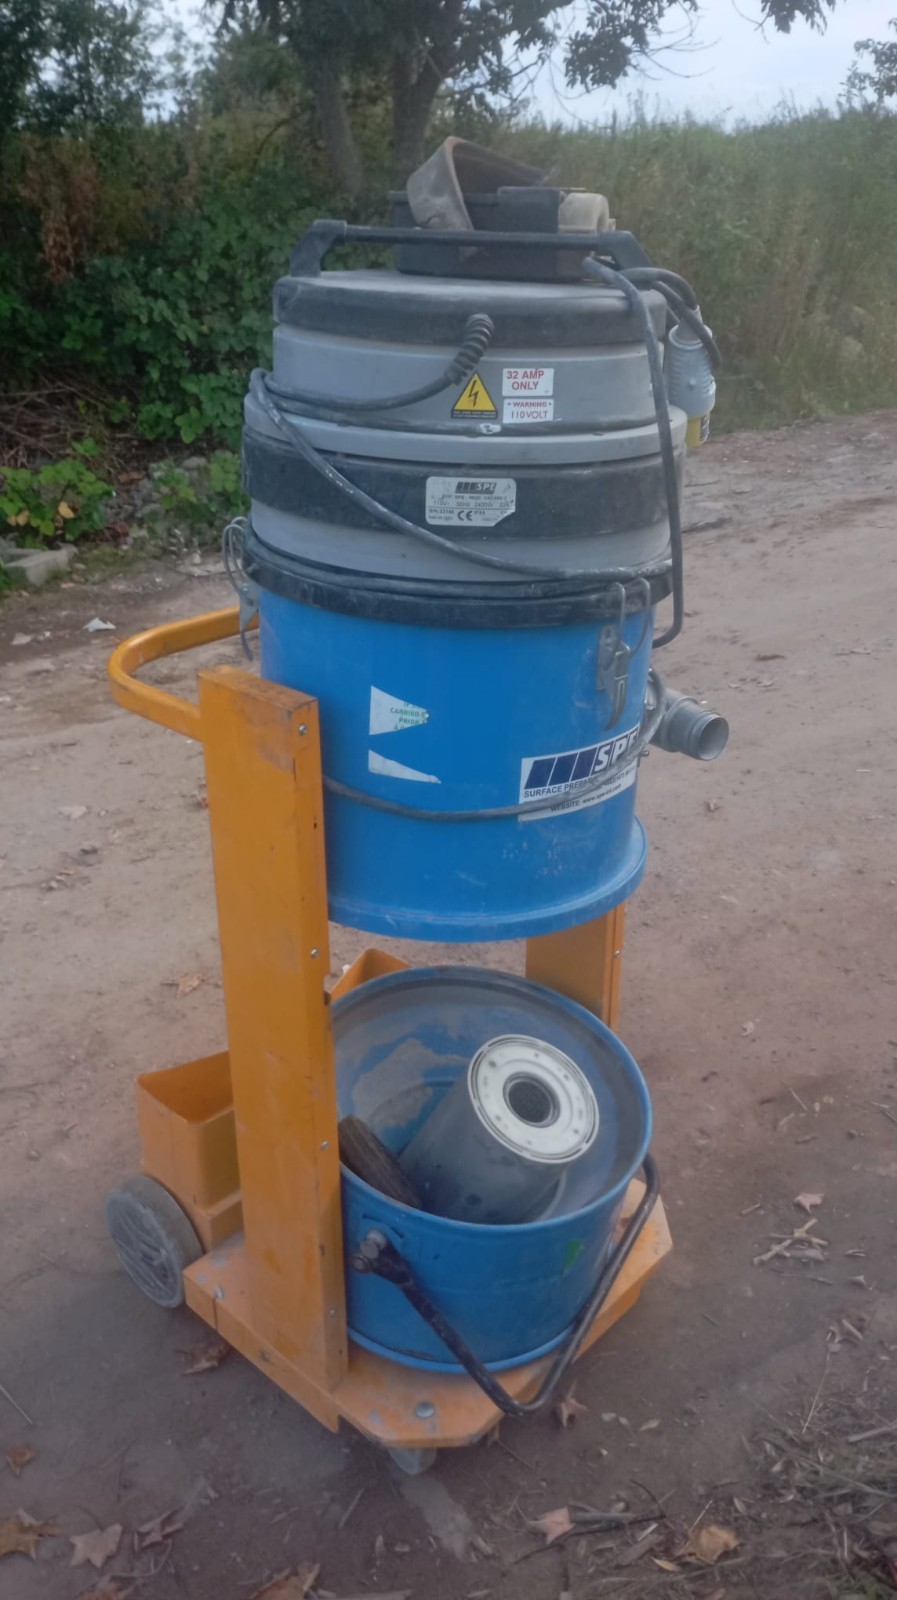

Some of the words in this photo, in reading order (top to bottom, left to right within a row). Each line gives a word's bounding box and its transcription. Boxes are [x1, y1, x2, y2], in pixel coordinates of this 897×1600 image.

[507, 370, 519, 380] 32
[522, 370, 545, 380] AMP
[512, 381, 539, 391] ONLY
[524, 784, 562, 798] SURFACE
